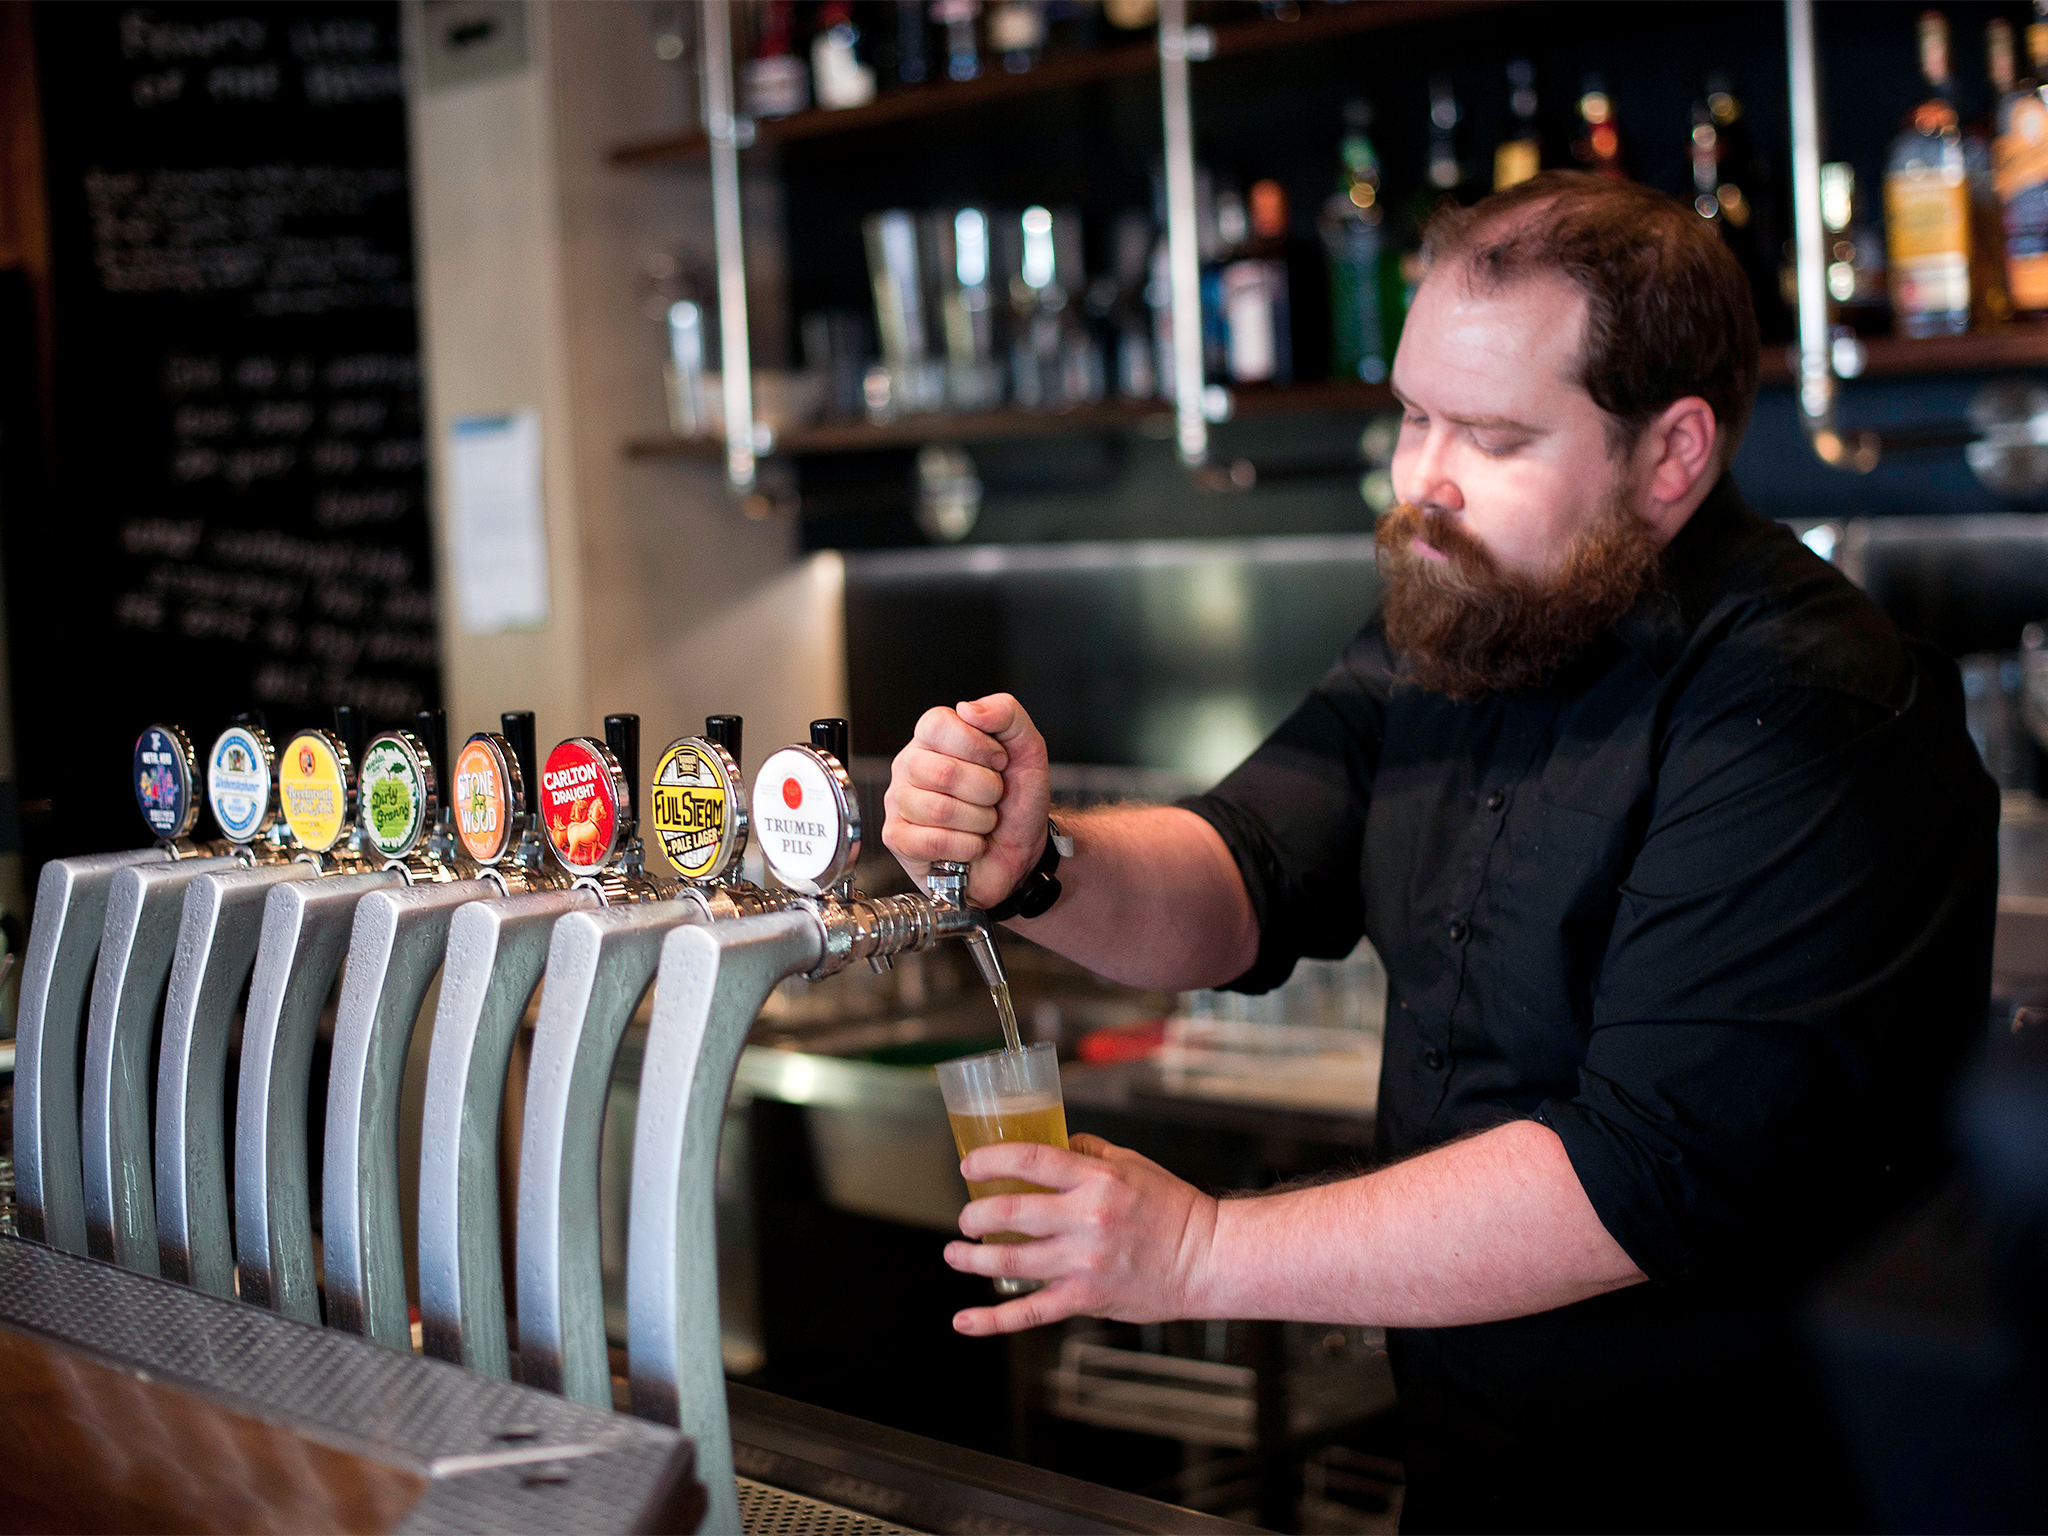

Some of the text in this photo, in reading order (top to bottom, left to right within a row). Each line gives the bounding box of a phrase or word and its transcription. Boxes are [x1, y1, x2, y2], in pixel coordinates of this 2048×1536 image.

[457, 769, 495, 804] STONE
[543, 762, 598, 791] CARLTON
[372, 787, 398, 809] Dirty
[551, 783, 595, 806] DRAUGHT
[376, 802, 410, 831] Granny
[460, 806, 497, 834] WOOD
[764, 817, 828, 838] TRUMER
[671, 827, 718, 855] PALE LAGER
[782, 838, 813, 855] PILS
